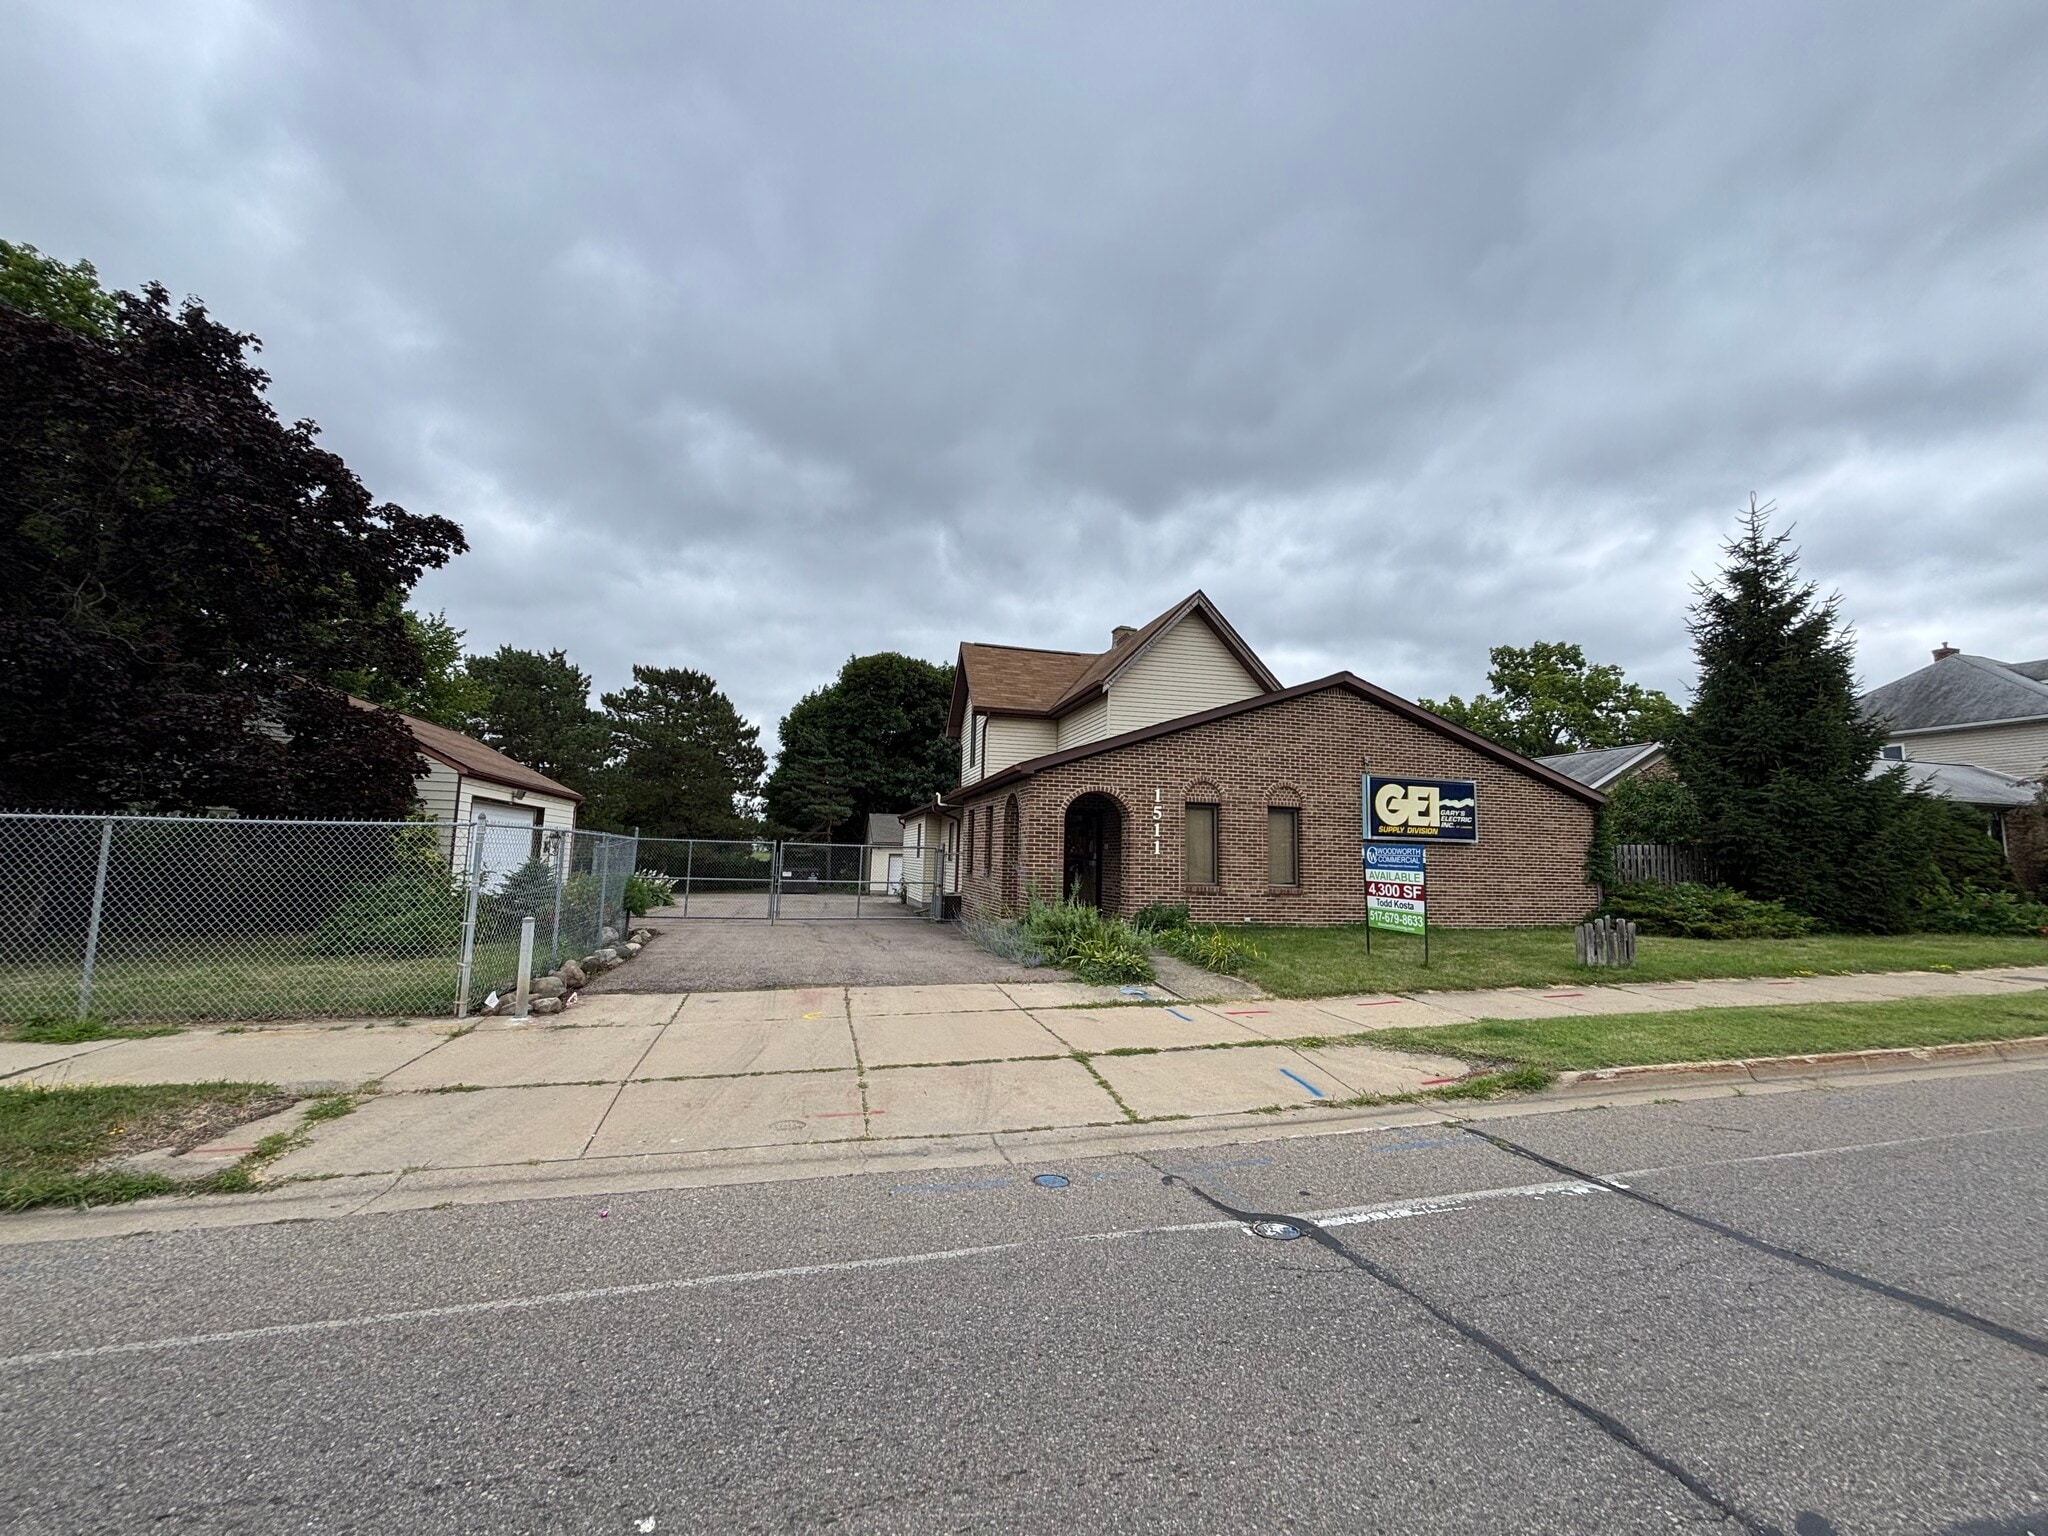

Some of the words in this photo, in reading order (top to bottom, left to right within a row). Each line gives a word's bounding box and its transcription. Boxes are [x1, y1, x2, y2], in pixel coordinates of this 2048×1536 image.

[1375, 783, 1440, 827] GEI
[1152, 788, 1163, 855] 1511
[1440, 815, 1473, 823] ELECTRIC
[1378, 825, 1405, 834] SUPPLY
[1406, 826, 1439, 835] DIVISION
[1377, 847, 1421, 855] WOODWORTH
[1377, 855, 1421, 864] COMMERCIAL
[1369, 870, 1421, 883] AVAILABLE
[1368, 882, 1400, 898] 4,300
[1403, 885, 1422, 899] SF
[1376, 898, 1392, 908] Todd
[1394, 900, 1415, 910] Kosta
[1369, 910, 1423, 928] 517-679-8633
